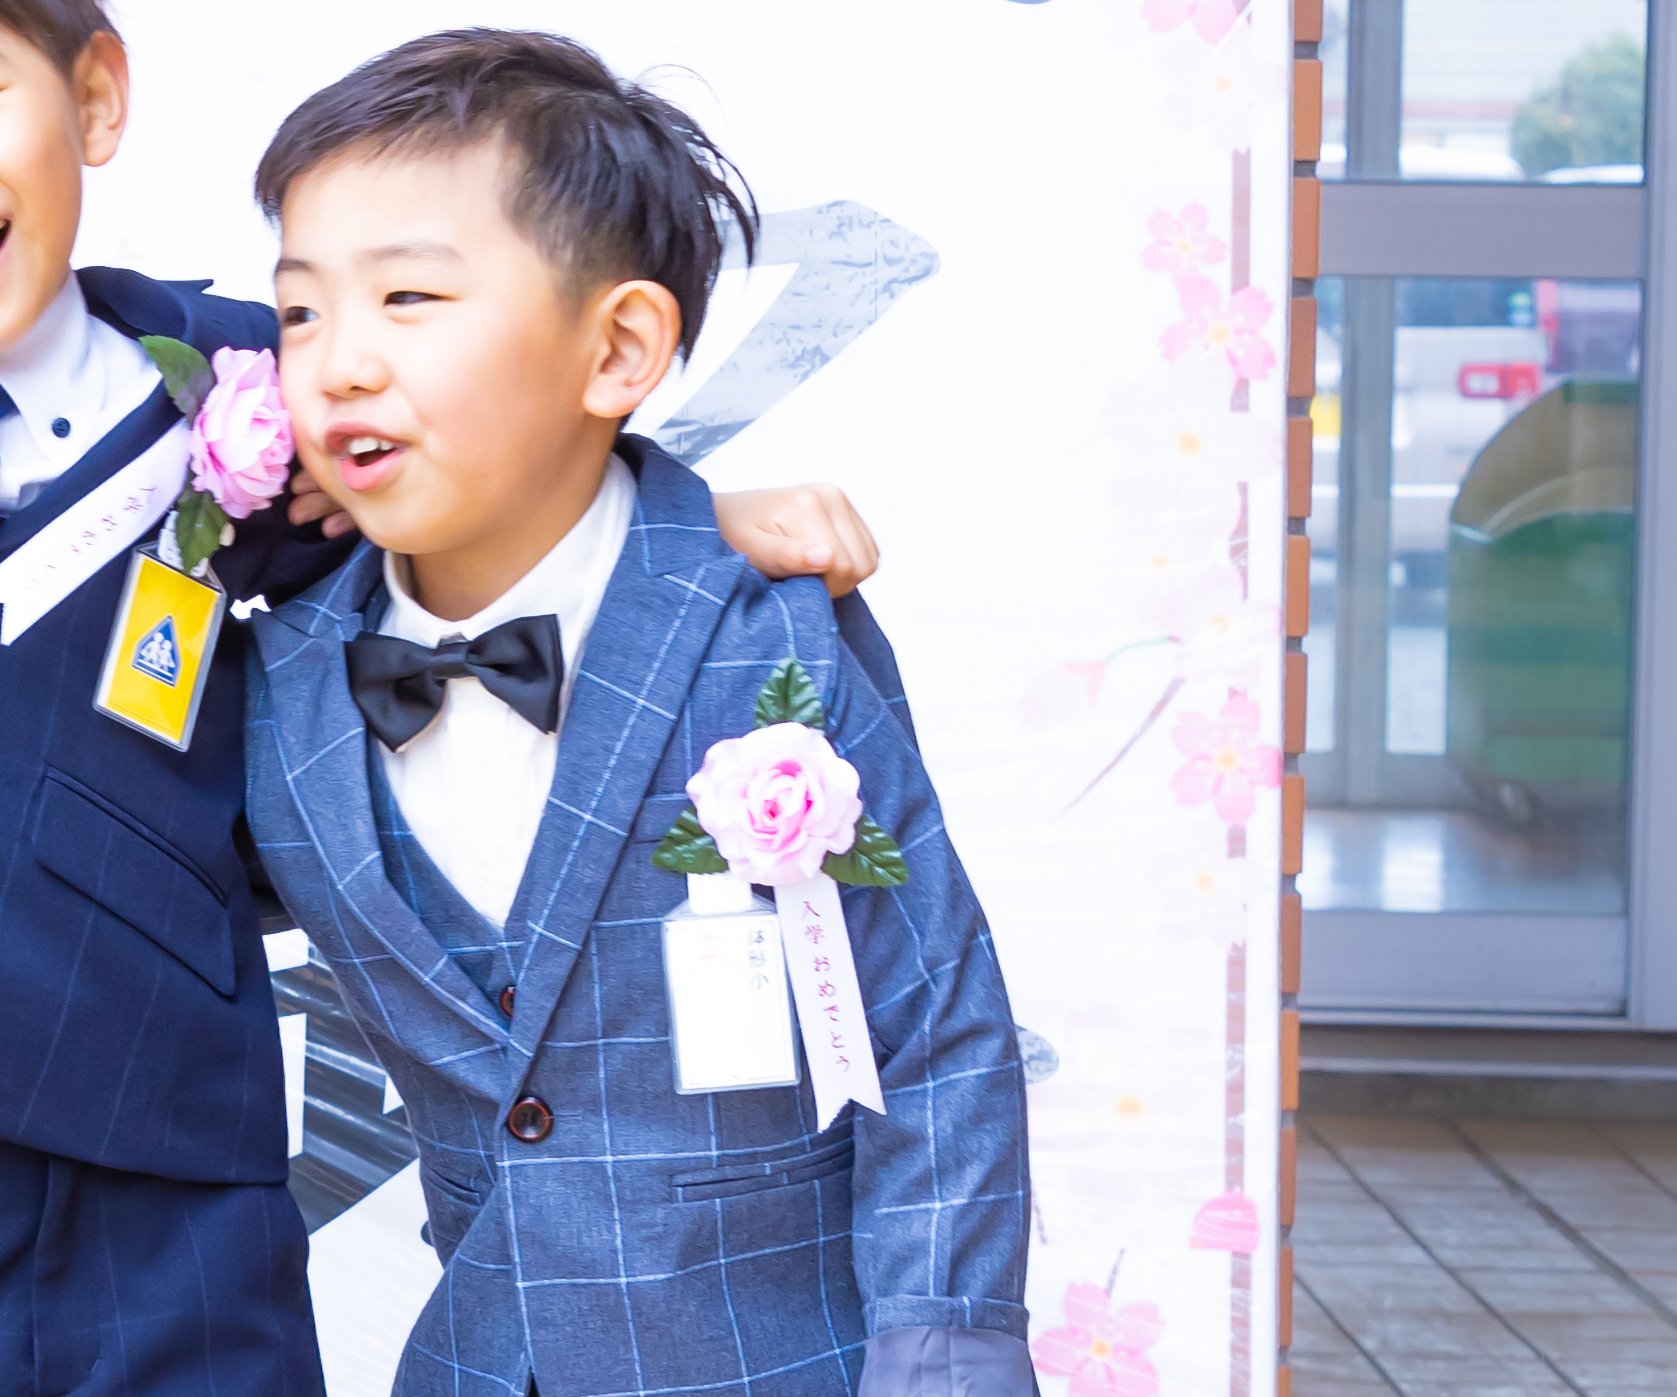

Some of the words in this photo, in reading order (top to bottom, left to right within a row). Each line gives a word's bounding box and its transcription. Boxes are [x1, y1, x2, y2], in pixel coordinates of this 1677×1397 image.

[801, 900, 851, 1073] 入学おめでとう
